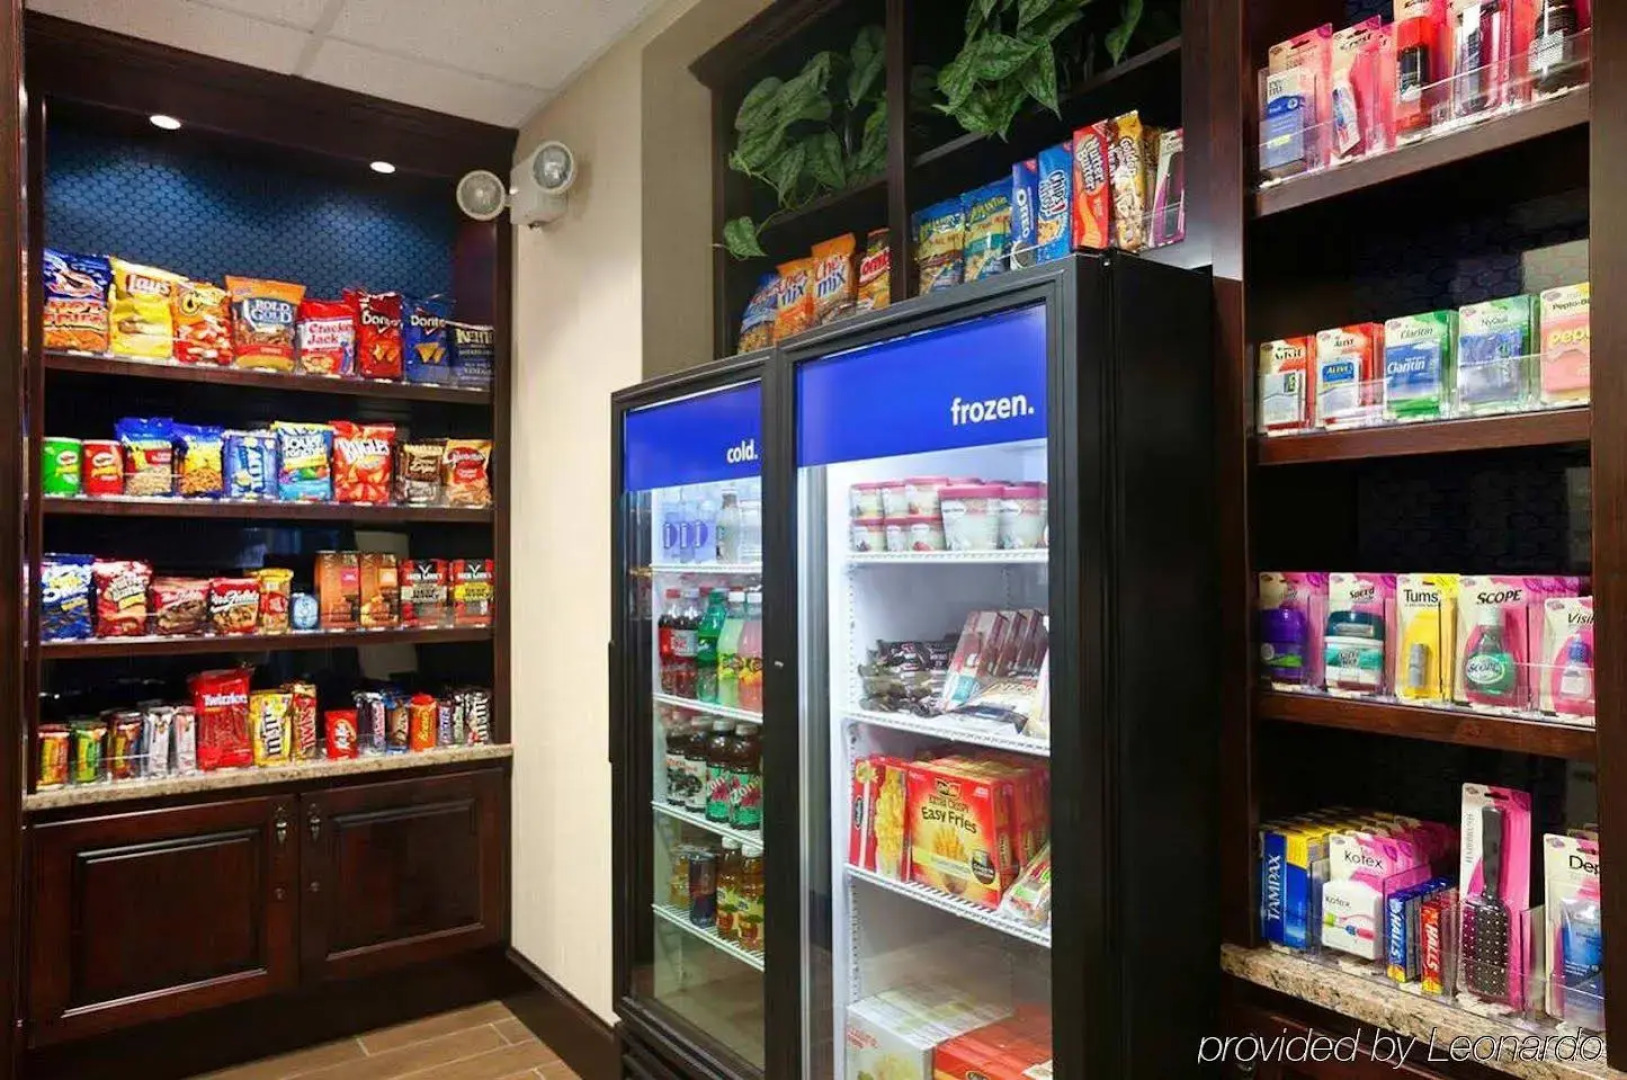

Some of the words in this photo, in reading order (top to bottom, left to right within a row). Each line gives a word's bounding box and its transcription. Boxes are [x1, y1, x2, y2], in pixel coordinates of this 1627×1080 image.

[1086, 136, 1104, 181] Nutter
[1048, 170, 1066, 205] Chips
[1017, 188, 1031, 238] OREO
[250, 308, 293, 323] GOLD
[254, 299, 290, 312] ROLD
[307, 334, 338, 344] Jack
[950, 394, 1035, 426] frozen.
[726, 440, 758, 464] cold.
[1404, 588, 1439, 603] Tums
[1476, 589, 1522, 605] SCOPE
[921, 806, 948, 823] Easy
[948, 811, 978, 834] Fries
[1344, 849, 1384, 870] Kotex
[1268, 853, 1282, 922] TAMPAX
[1389, 912, 1403, 957] HALLS
[1425, 923, 1441, 973] HALLS
